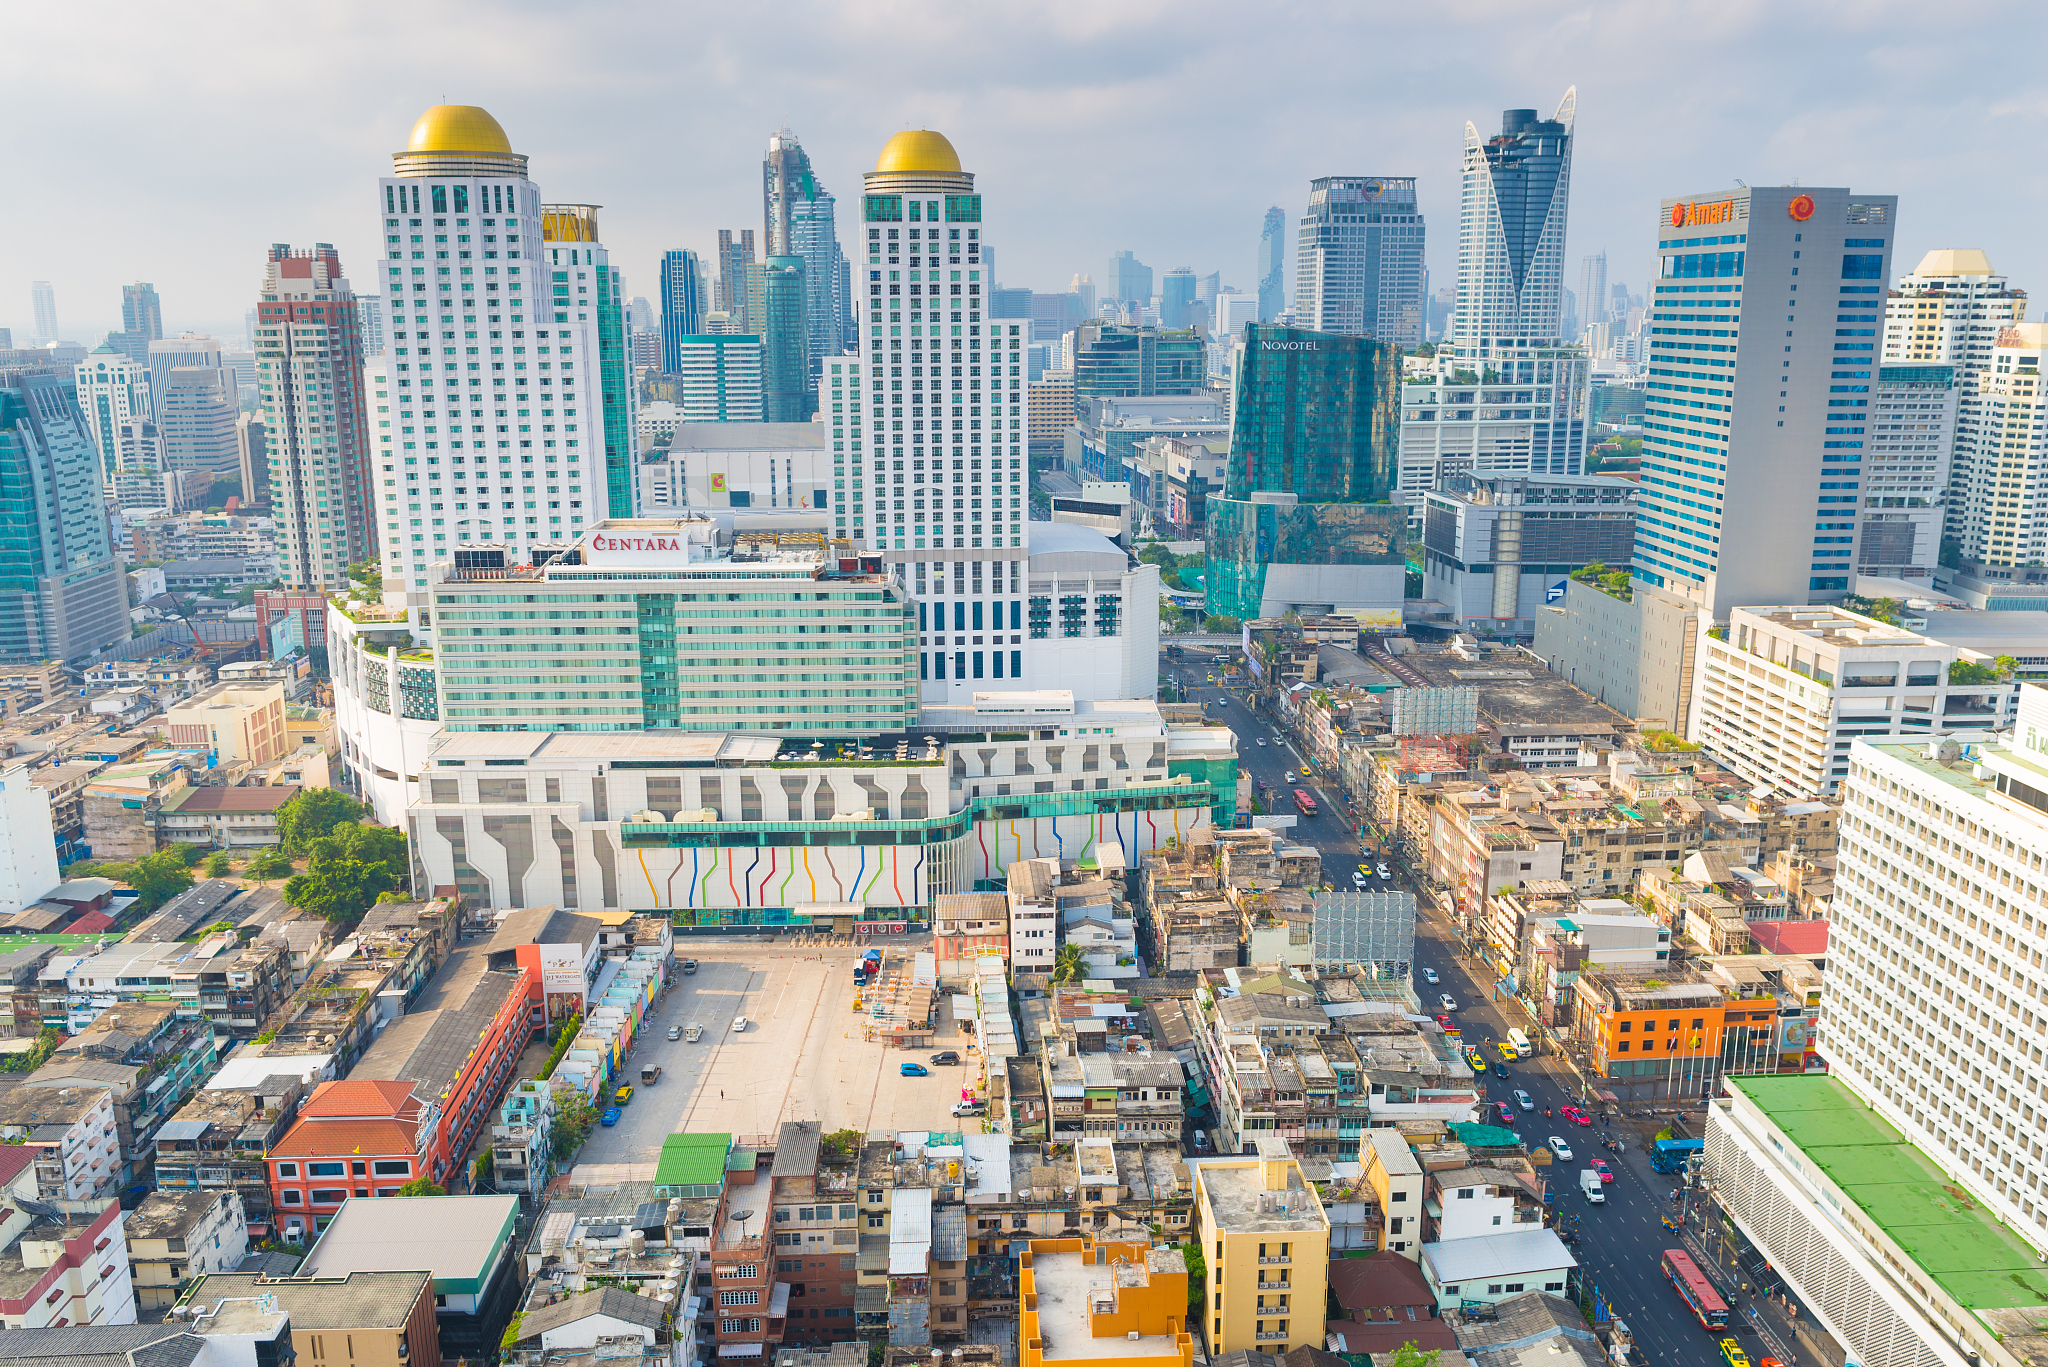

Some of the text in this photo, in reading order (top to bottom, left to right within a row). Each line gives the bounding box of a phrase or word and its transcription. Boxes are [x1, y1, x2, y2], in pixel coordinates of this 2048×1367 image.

[1685, 200, 1732, 226] Amari
[1998, 328, 2020, 338] GRAND
[1261, 340, 1320, 351] NOVOTEL
[592, 533, 680, 551] CENTARA
